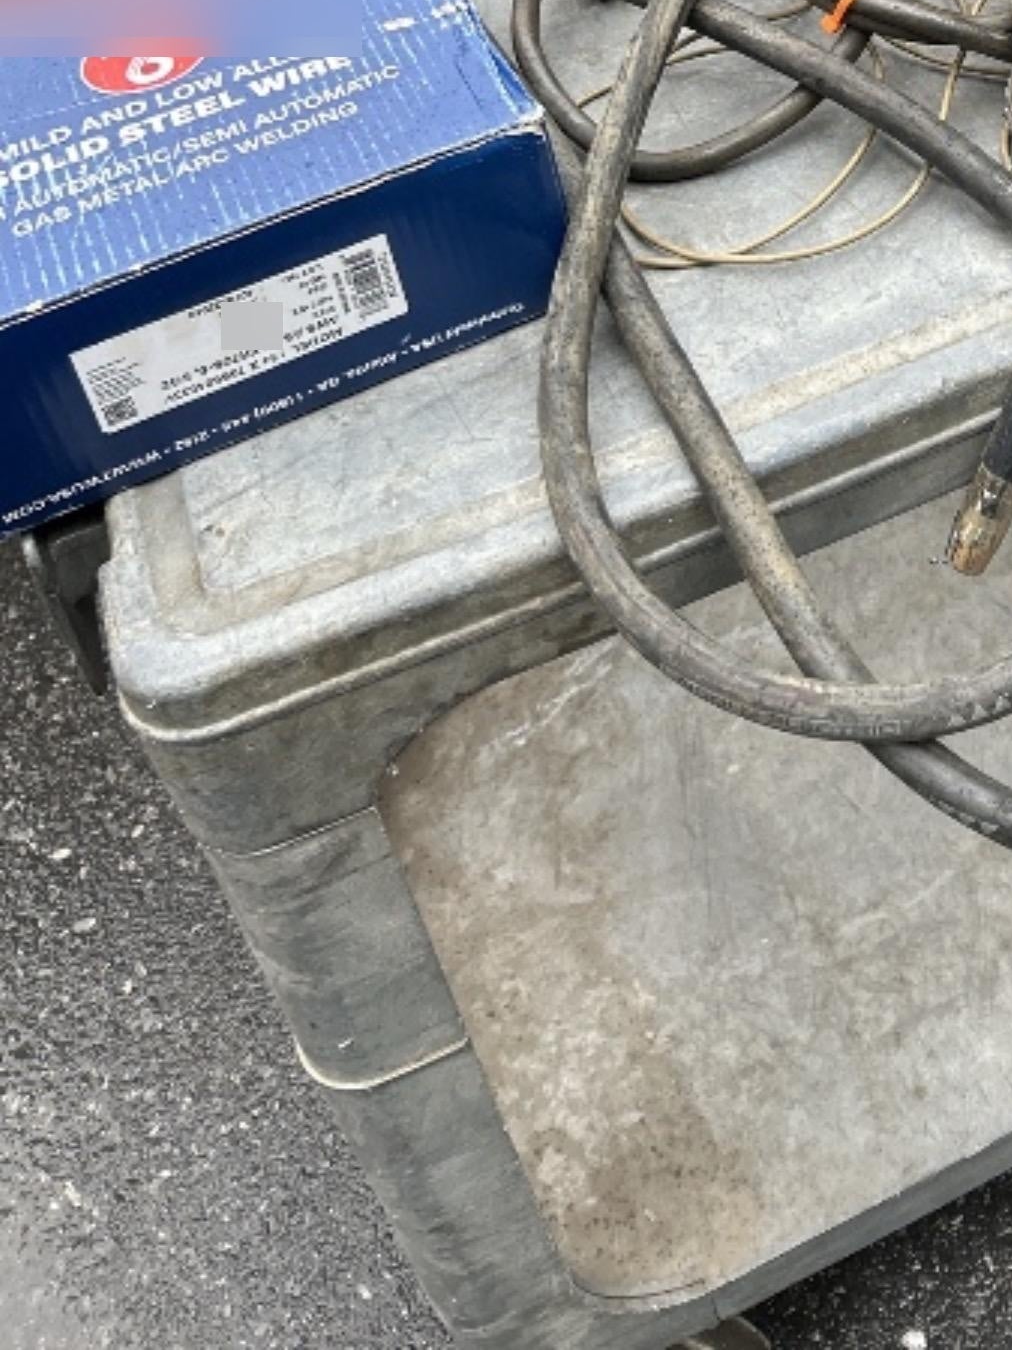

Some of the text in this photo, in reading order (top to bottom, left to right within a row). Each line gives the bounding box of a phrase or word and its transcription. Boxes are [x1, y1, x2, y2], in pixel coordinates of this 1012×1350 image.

[0, 124, 73, 162] MILD
[80, 100, 148, 136] AND
[154, 71, 224, 109] LOW
[118, 92, 246, 148] STEEL
[253, 64, 401, 131] AUTOMATIC
[11, 204, 72, 238] GAS
[77, 169, 168, 214] METAL
[175, 148, 231, 179] ARC
[233, 101, 359, 156] WELDING
